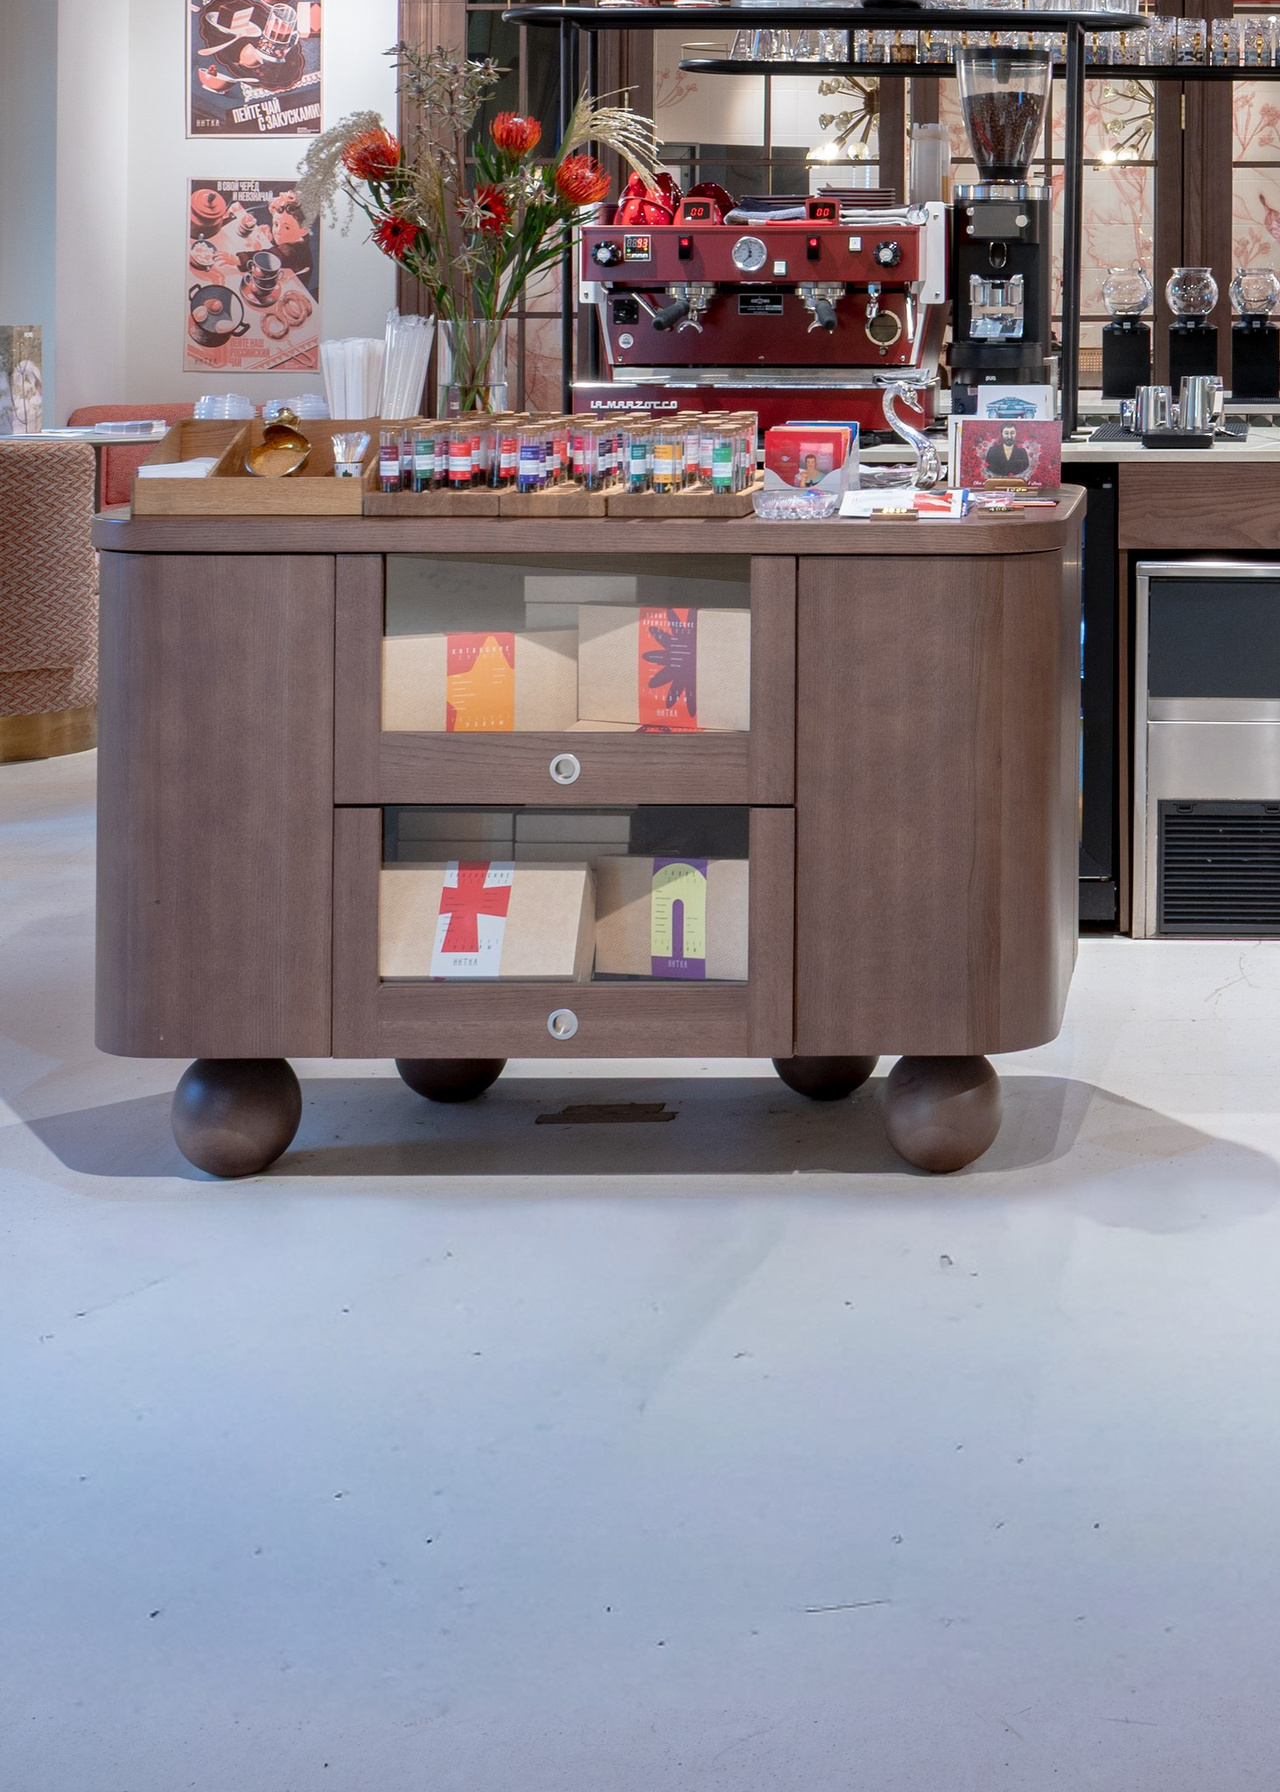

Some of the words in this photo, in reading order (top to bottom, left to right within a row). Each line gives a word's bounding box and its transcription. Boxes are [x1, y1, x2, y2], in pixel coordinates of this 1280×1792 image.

[232, 103, 262, 124] ПЕЙТЕ
[261, 97, 281, 117] ЧАЙ
[257, 116, 267, 131] С
[690, 207, 704, 216] 00
[816, 208, 830, 217] 00
